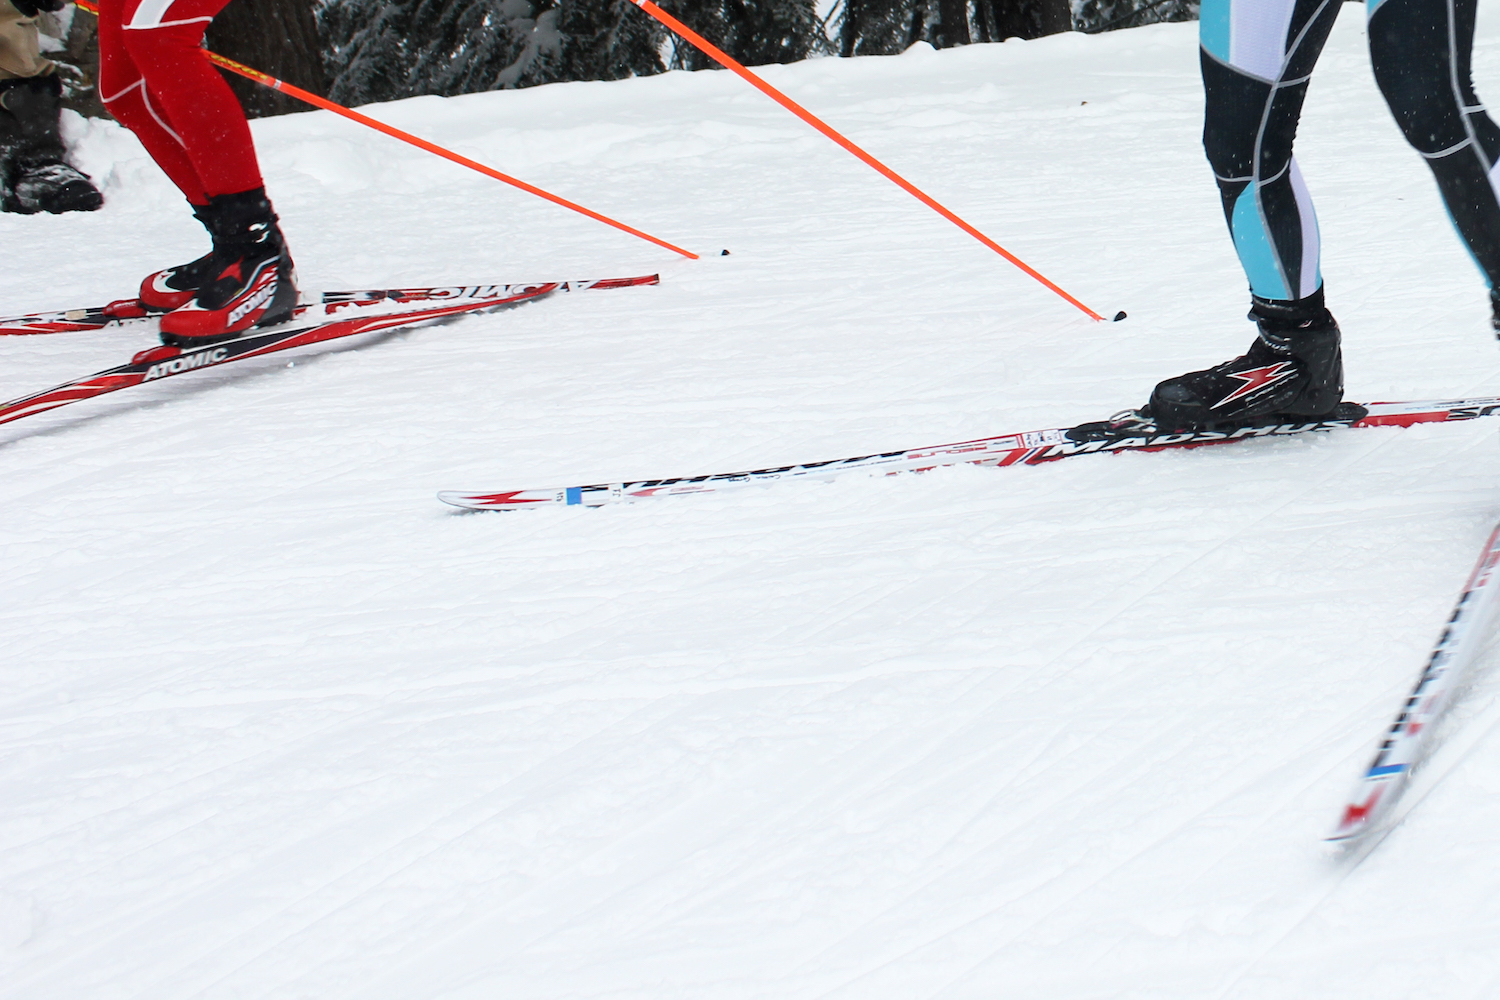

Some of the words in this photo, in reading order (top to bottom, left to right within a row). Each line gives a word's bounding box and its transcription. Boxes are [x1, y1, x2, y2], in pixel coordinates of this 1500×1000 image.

[227, 282, 277, 327] ATOMIC
[143, 348, 228, 381] ATOMIC
[1041, 420, 1356, 459] MADSHUS
